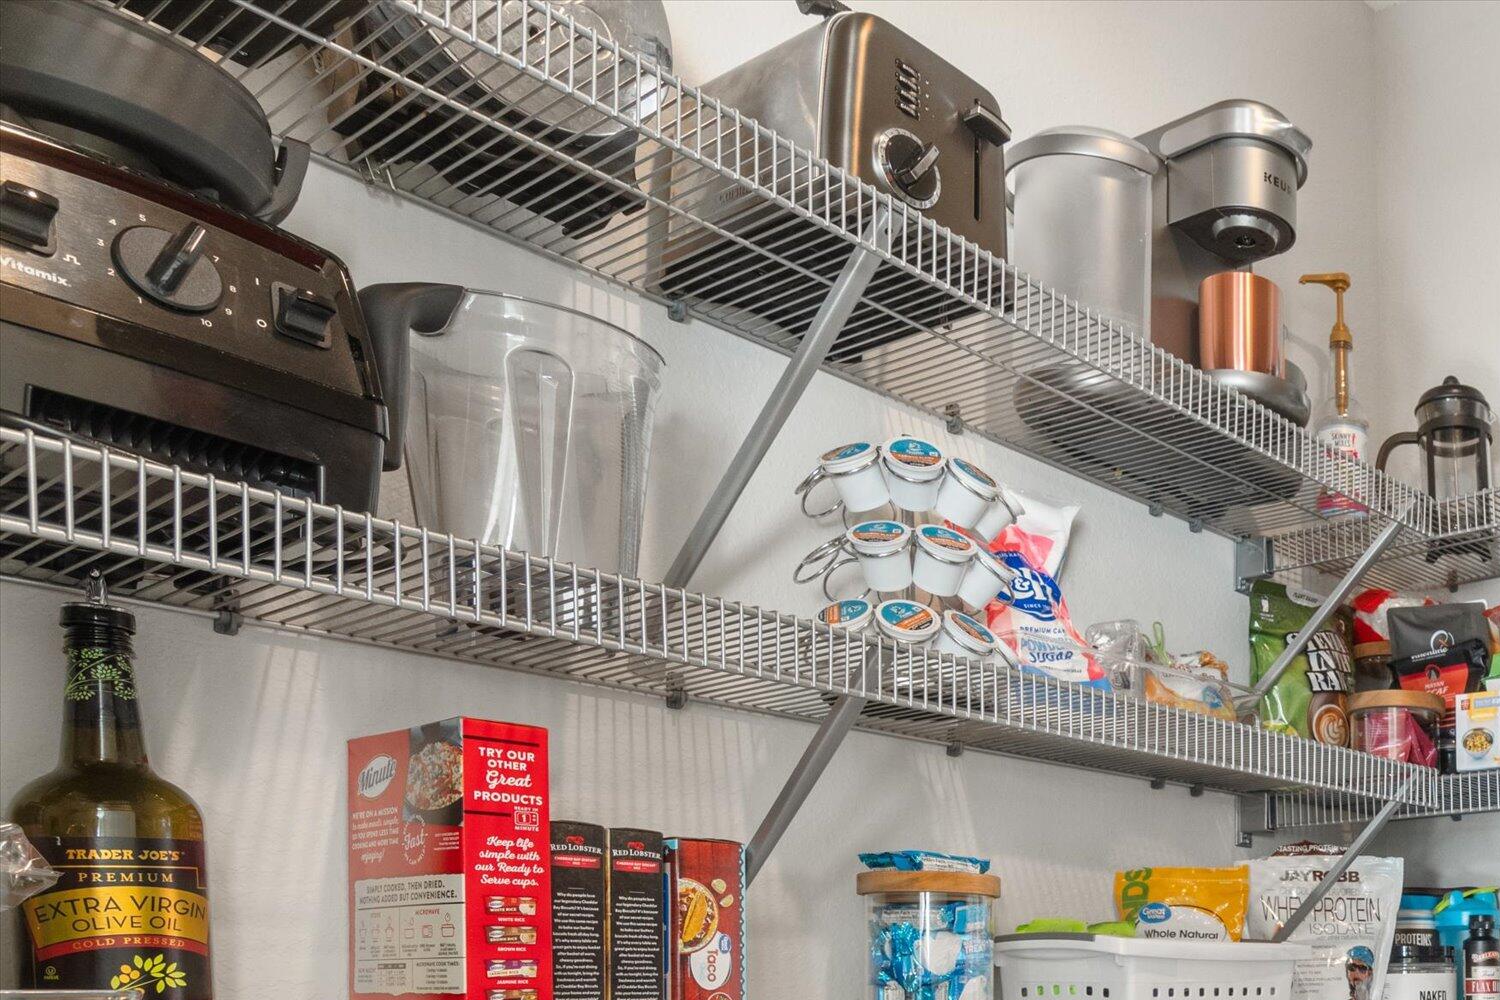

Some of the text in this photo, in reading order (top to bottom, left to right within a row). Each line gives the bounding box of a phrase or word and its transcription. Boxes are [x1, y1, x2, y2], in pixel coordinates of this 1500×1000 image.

[478, 746, 535, 762] TRY OUR
[487, 759, 527, 771] OTHER
[486, 769, 532, 789] Great
[474, 790, 543, 806] PRODUCTS
[486, 835, 534, 851] Keep life
[550, 843, 602, 855] RED LOBSTER
[66, 849, 180, 861] TRADER JOE'S
[479, 849, 516, 862] simple
[517, 852, 541, 861] with
[612, 848, 661, 859] RED LOBSTER
[474, 862, 545, 876] our Ready to
[78, 872, 174, 883] PREMIUM
[480, 873, 539, 889] Serve cups.
[35, 895, 207, 924] EXTRA VIRGIN
[1313, 897, 1381, 922] PROTEIN
[72, 915, 182, 933] OLIVE OIL
[1309, 922, 1376, 936] ISOLATE
[1144, 929, 1219, 940] Whole Natural
[1394, 933, 1432, 946] PROTEINS
[72, 936, 185, 950] COLD PRESSED
[1471, 981, 1490, 992] FLAX
